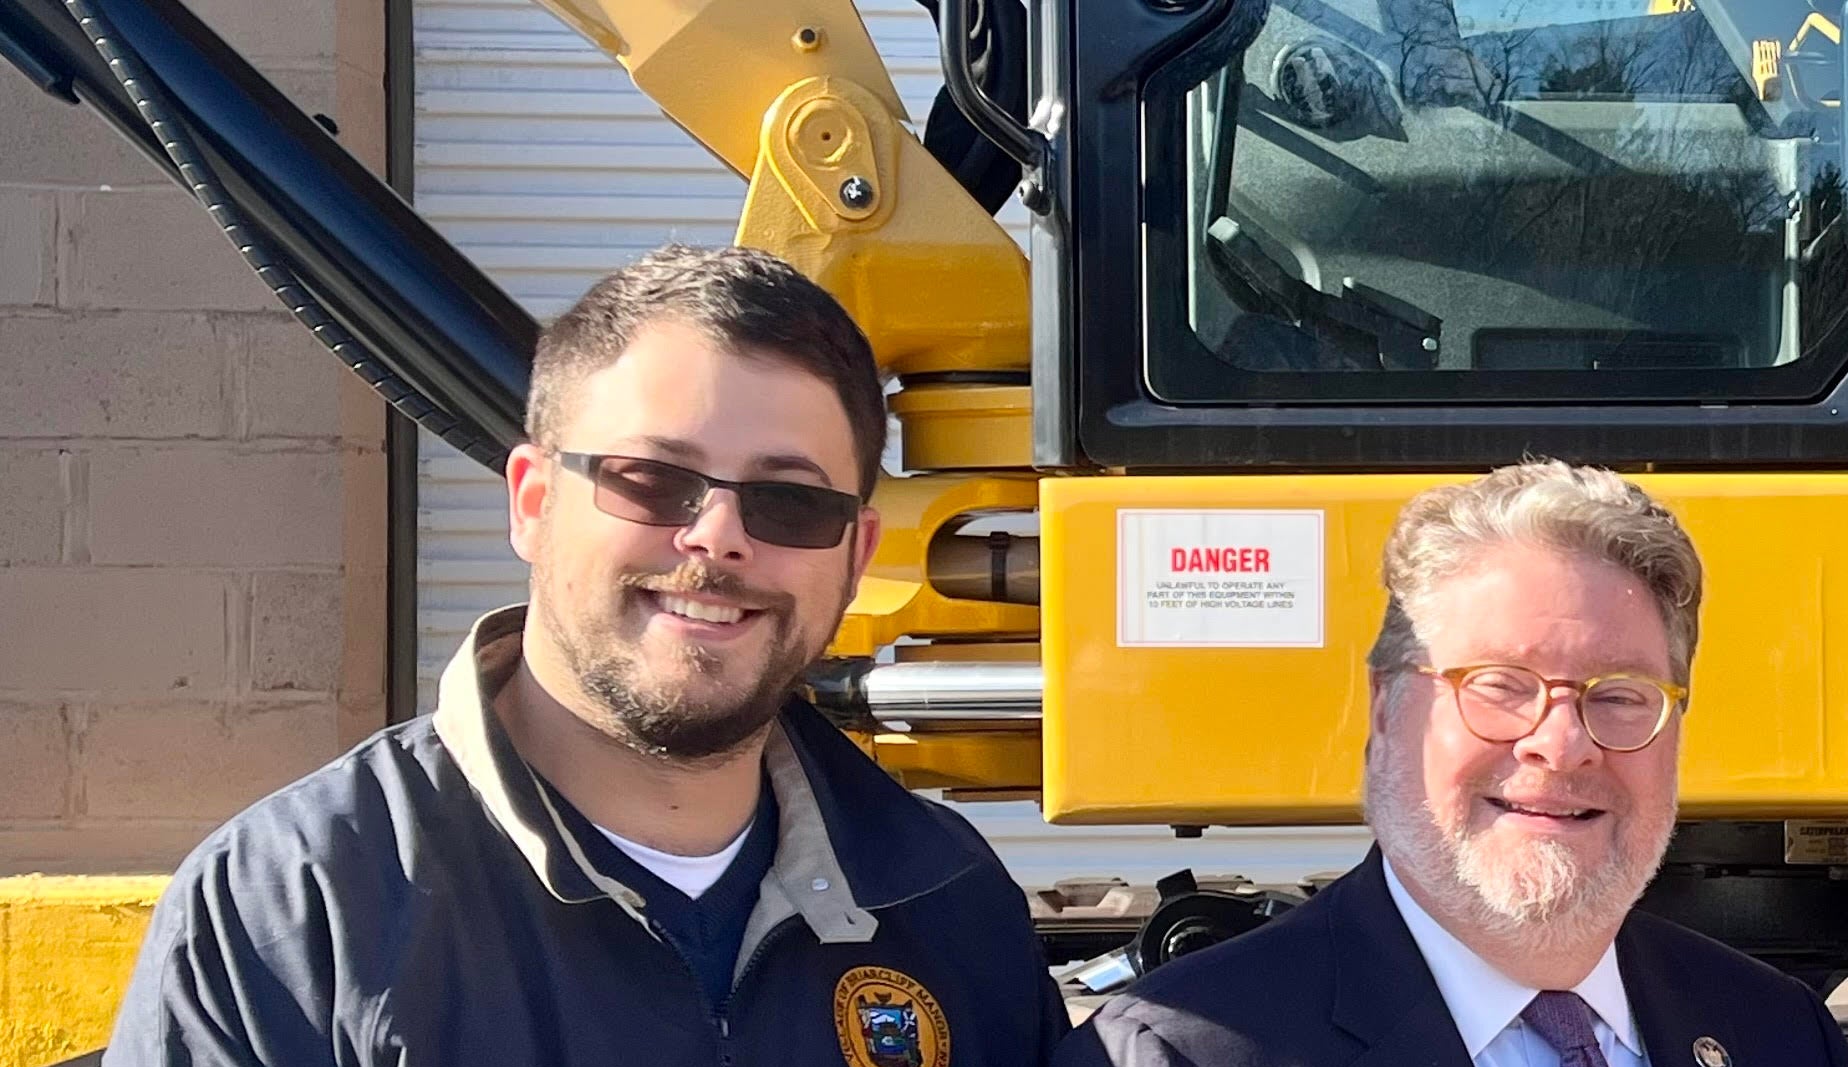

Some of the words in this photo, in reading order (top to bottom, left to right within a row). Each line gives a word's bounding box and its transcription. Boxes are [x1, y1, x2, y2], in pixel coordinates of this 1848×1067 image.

[1171, 548, 1270, 572] DANGER
[1156, 582, 1205, 590] UNLAWFUL
[1207, 582, 1219, 590] TO
[1222, 582, 1263, 590] OPERATE
[1266, 582, 1285, 590] ANY
[1147, 591, 1169, 599] PART
[1172, 591, 1185, 599] OF
[1187, 591, 1207, 599] THIS
[1209, 591, 1261, 599] EQUIPMENT
[1263, 591, 1295, 599] WITHIN
[1161, 601, 1183, 609] FEET
[1186, 601, 1198, 609] OF
[1200, 601, 1222, 609] HIGH
[1225, 601, 1265, 609] VOLTAGE
[1267, 601, 1294, 609] LINES
